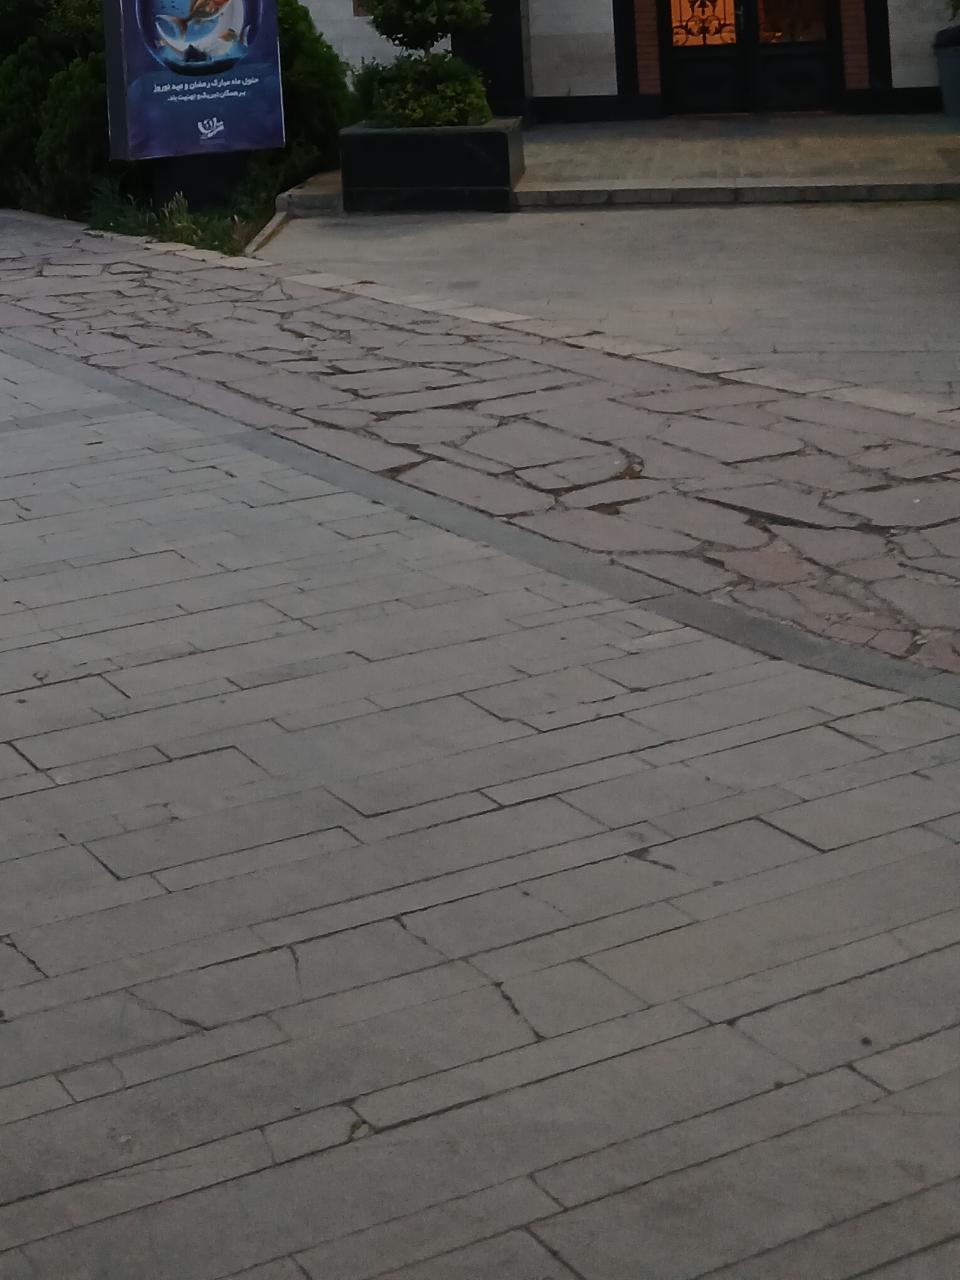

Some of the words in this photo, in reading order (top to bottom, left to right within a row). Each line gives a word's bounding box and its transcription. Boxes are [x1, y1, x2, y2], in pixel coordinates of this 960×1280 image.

[189, 80, 211, 89] رمضان
[210, 78, 231, 88] مبارک
[231, 77, 241, 85] ماه
[153, 83, 170, 93] نوروز
[184, 83, 189, 91] و
